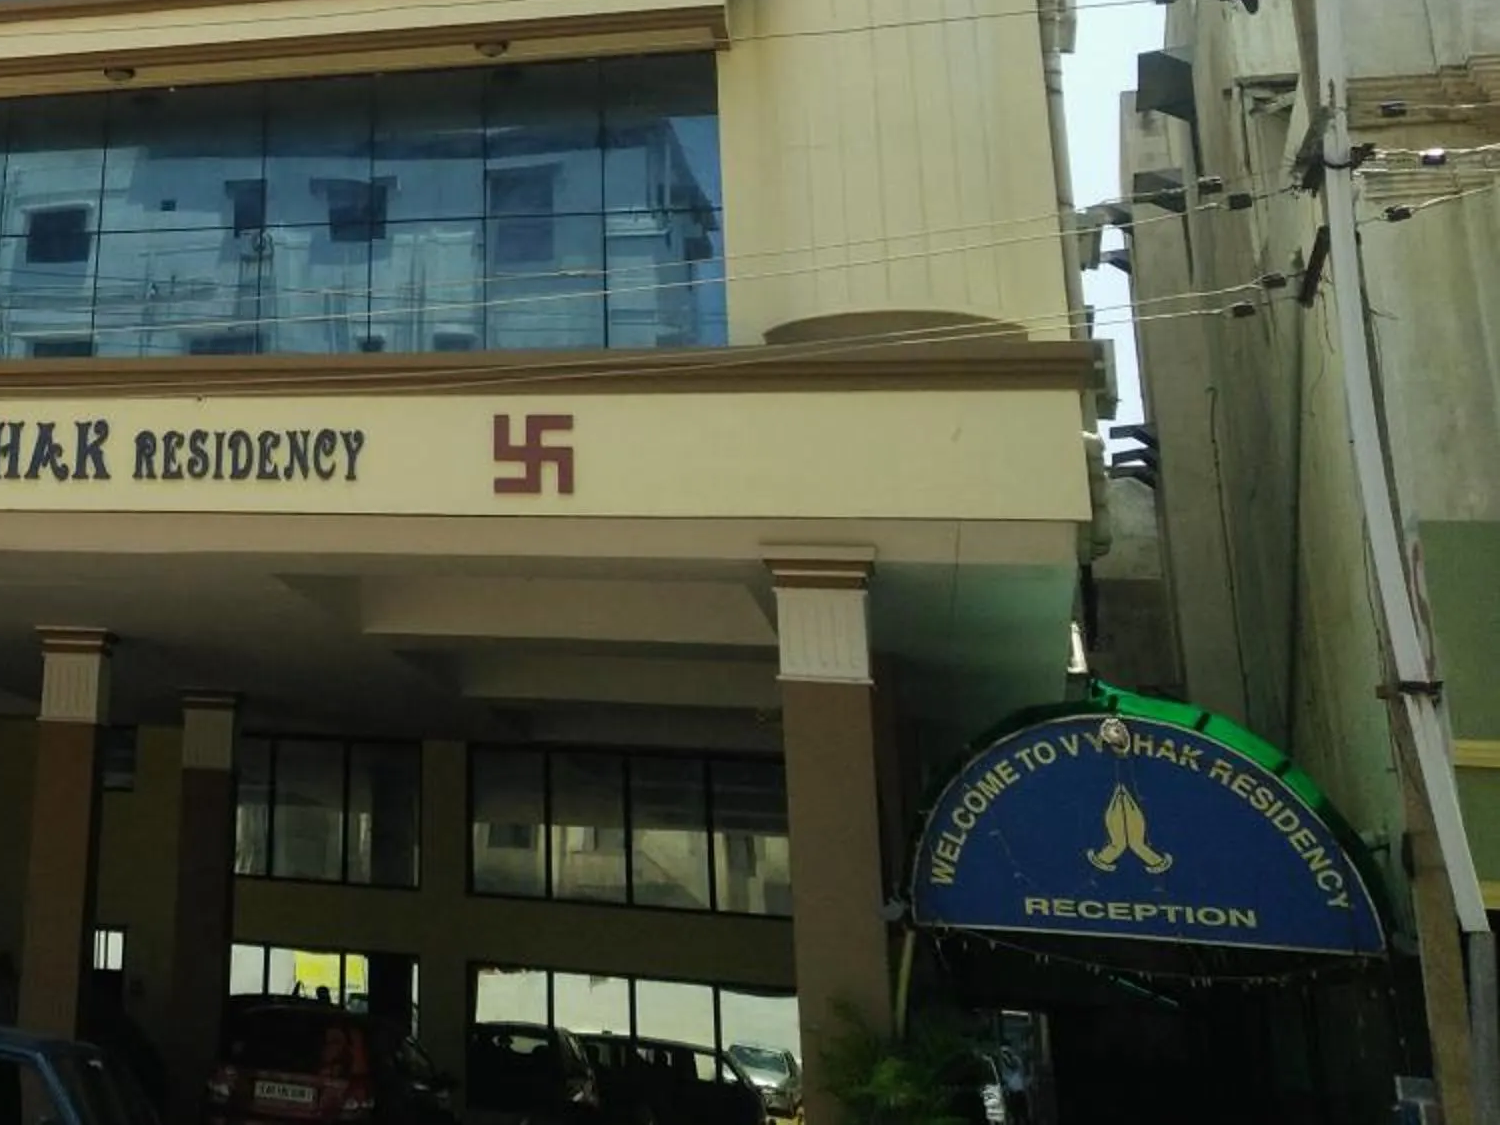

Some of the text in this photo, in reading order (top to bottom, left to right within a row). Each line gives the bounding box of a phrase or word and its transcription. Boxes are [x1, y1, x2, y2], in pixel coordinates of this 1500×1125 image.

[131, 428, 366, 482] RESIDENCY
[929, 730, 1350, 909] WELCOME TO VYHAK RESIDENCY
[1023, 896, 1258, 929] RECEPTION
